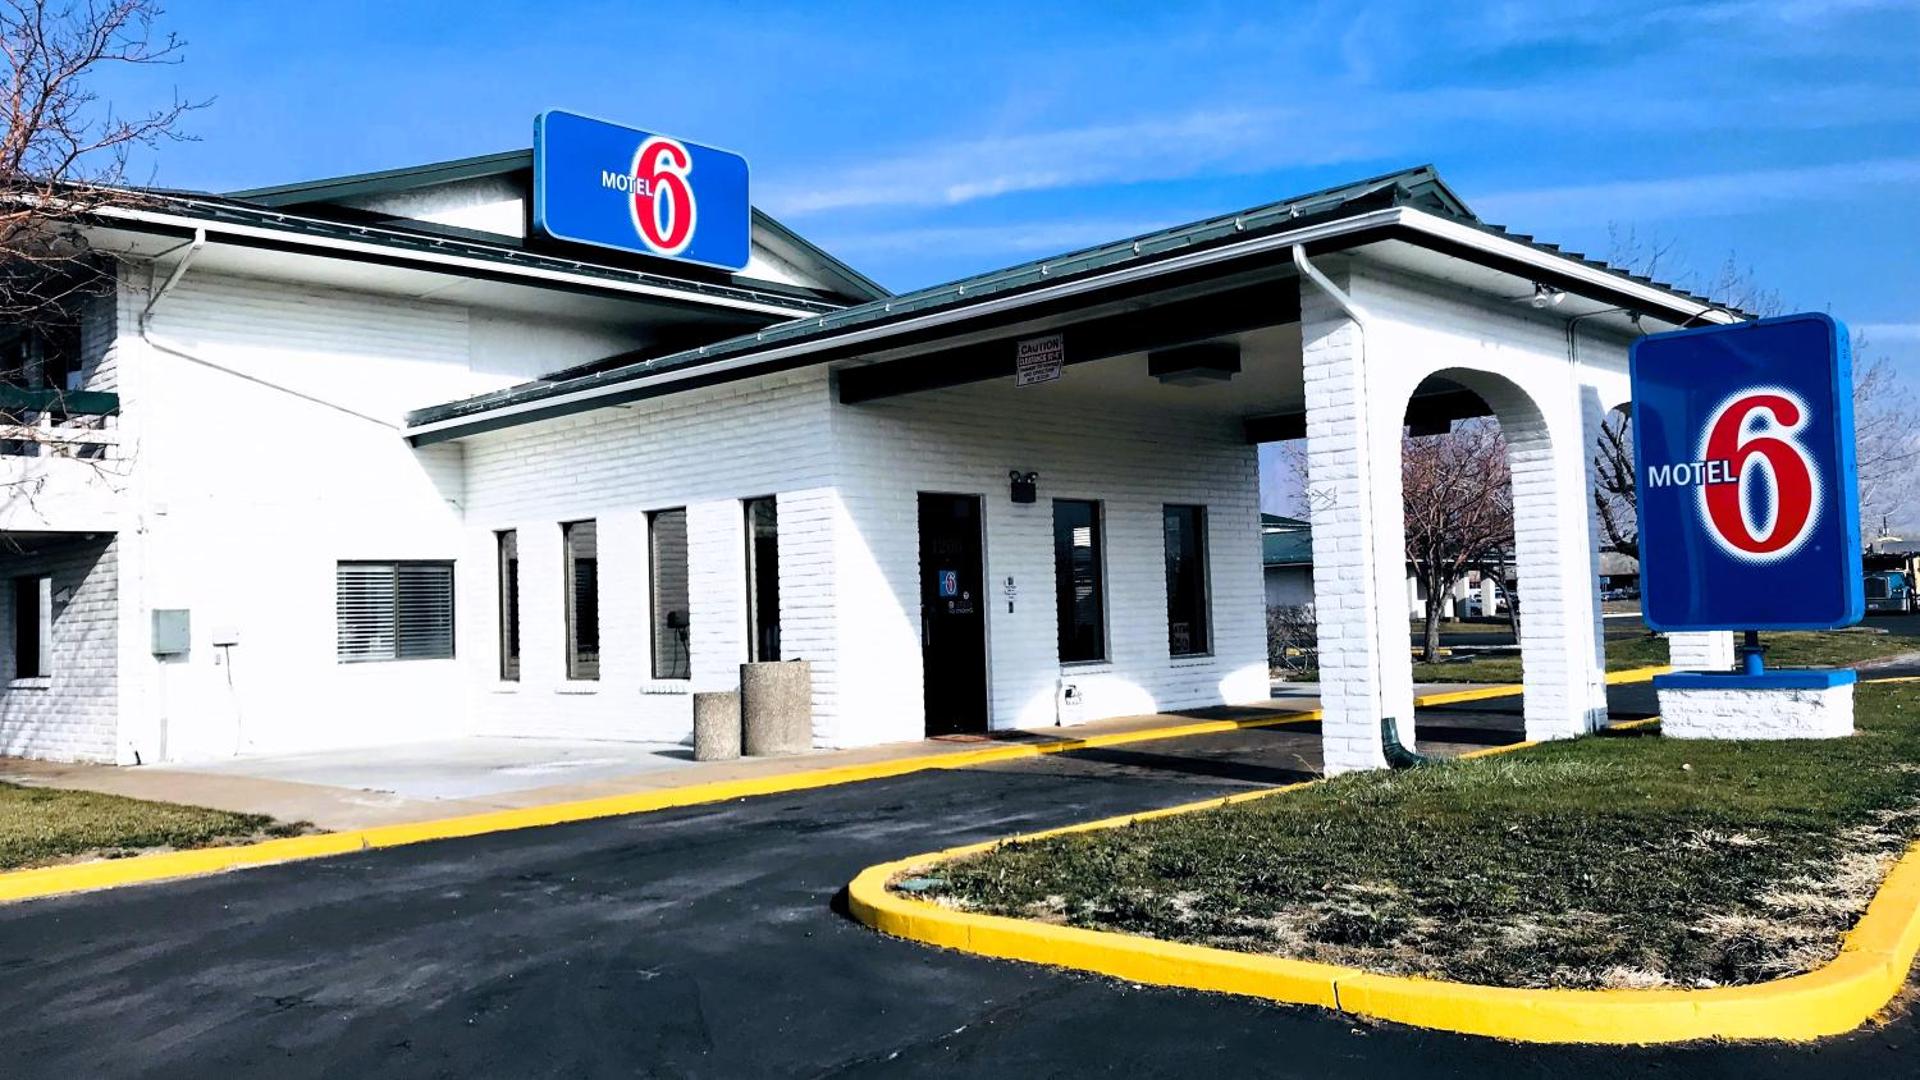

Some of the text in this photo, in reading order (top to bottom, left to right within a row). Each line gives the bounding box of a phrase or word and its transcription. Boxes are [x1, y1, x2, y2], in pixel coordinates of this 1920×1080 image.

[602, 138, 694, 254] MOTEL 6
[1021, 338, 1059, 355] CAUTION
[1648, 390, 1817, 560] MOTEL 6
